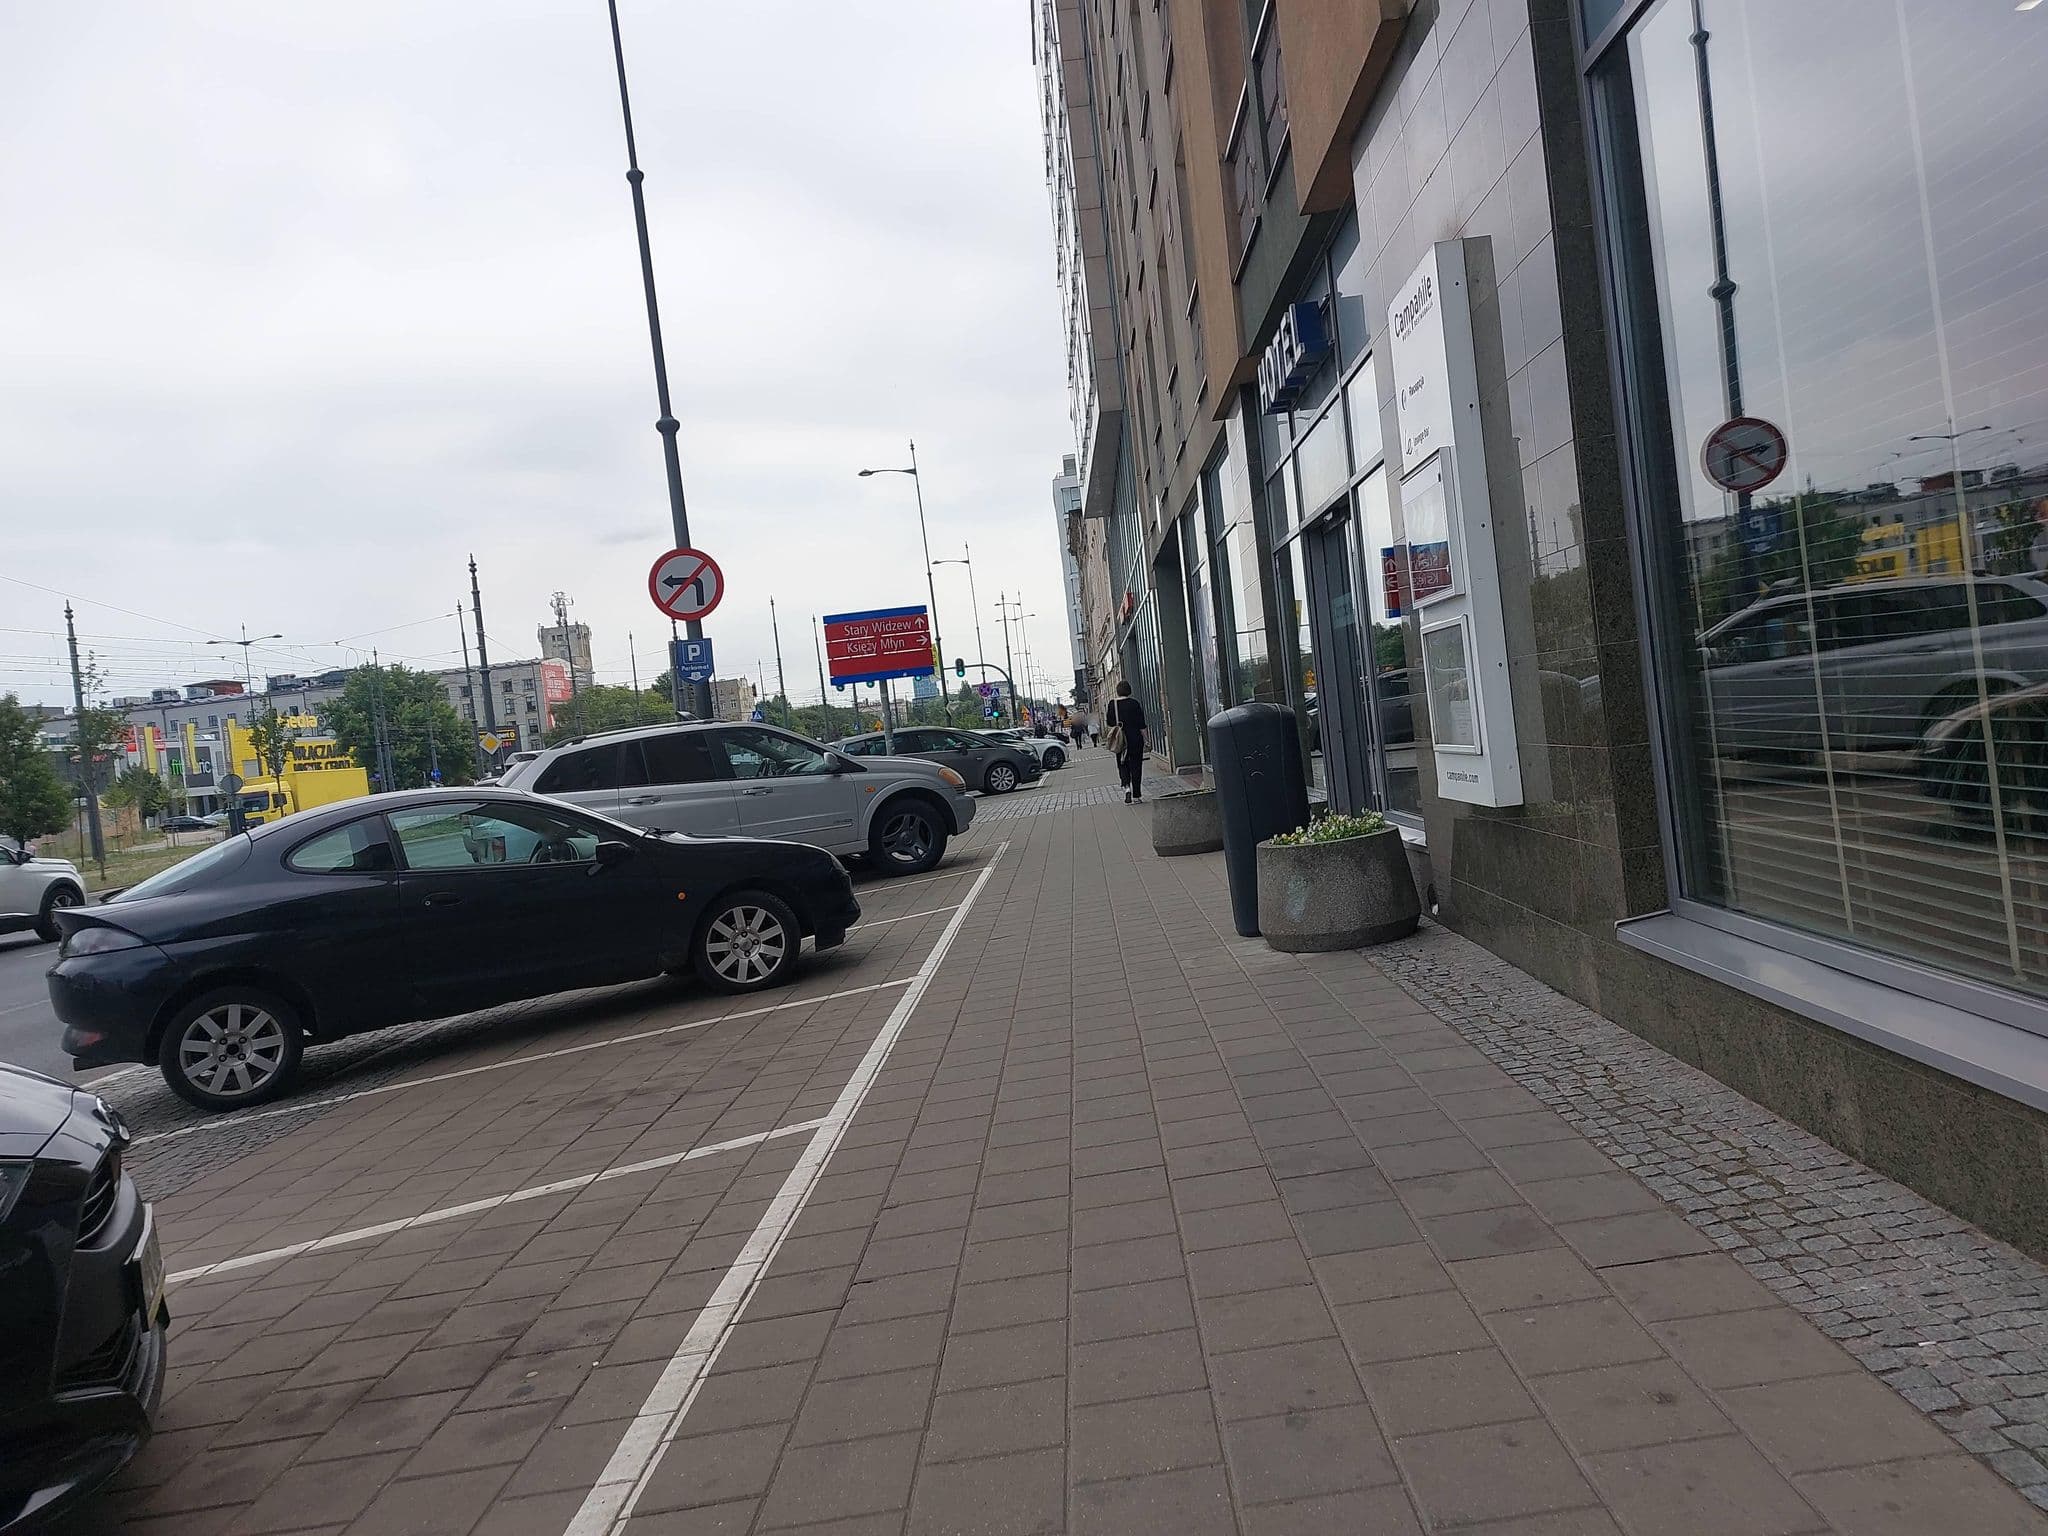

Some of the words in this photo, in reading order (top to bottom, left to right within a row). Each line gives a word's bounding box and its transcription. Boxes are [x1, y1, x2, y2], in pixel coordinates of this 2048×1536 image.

[1394, 275, 1432, 338] Campanile
[1257, 303, 1304, 416] HOTEL
[844, 624, 869, 637] Stary
[871, 619, 911, 633] Widzew
[688, 644, 700, 661] P
[847, 641, 877, 654] Księży
[880, 637, 905, 651] Młyn
[1446, 770, 1479, 784] campanile.com
